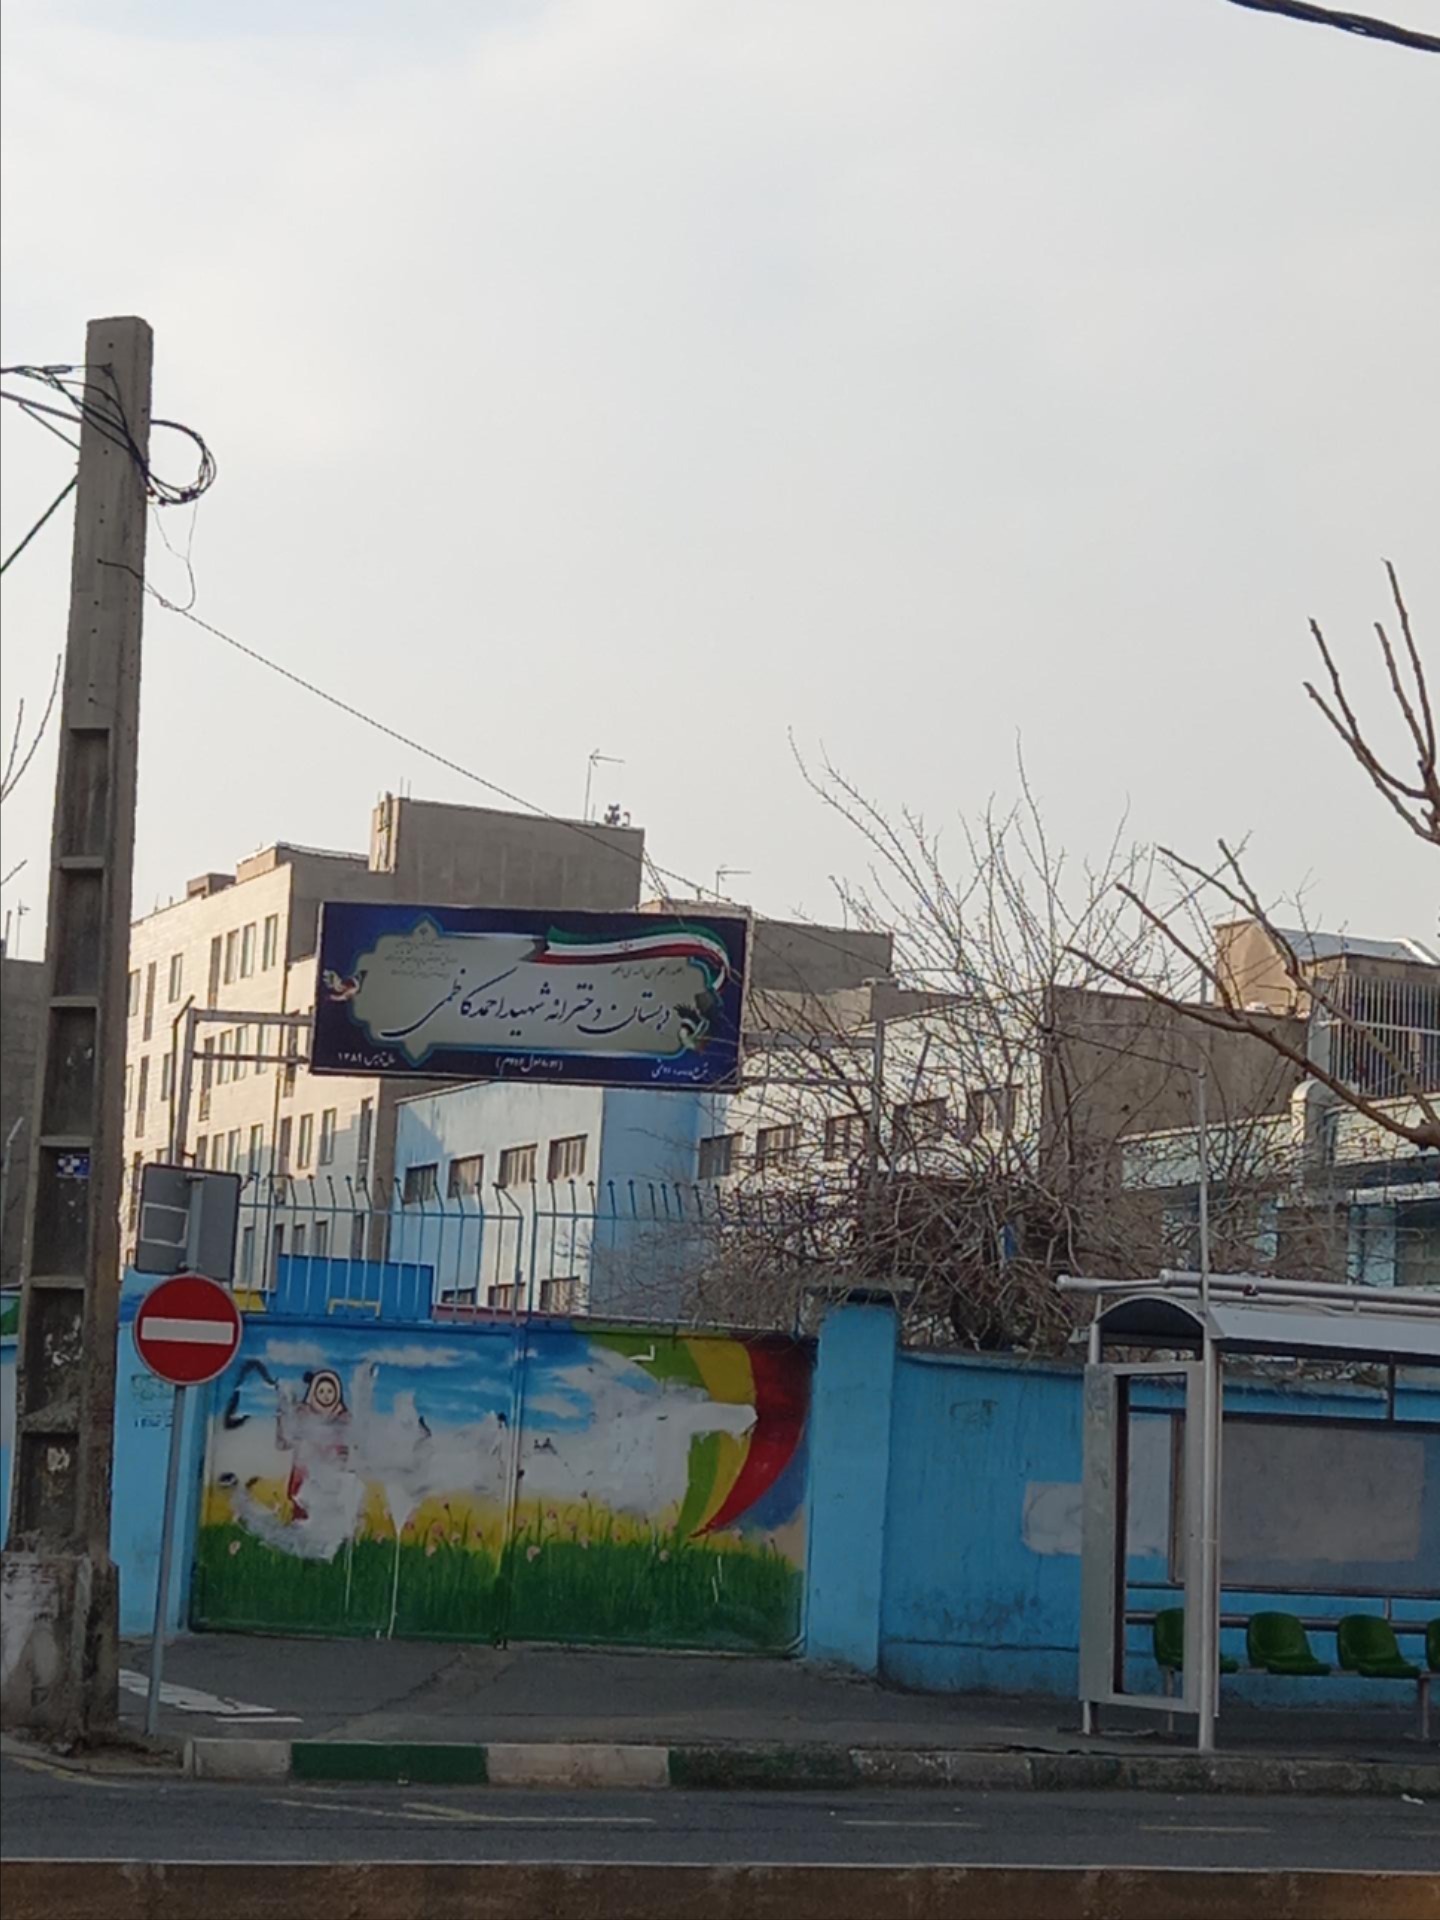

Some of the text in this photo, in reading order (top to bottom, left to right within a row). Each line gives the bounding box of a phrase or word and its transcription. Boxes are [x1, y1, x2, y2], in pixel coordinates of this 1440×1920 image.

[379, 966, 671, 1038] دبستان دخترانه شهید احمد کاظمی
